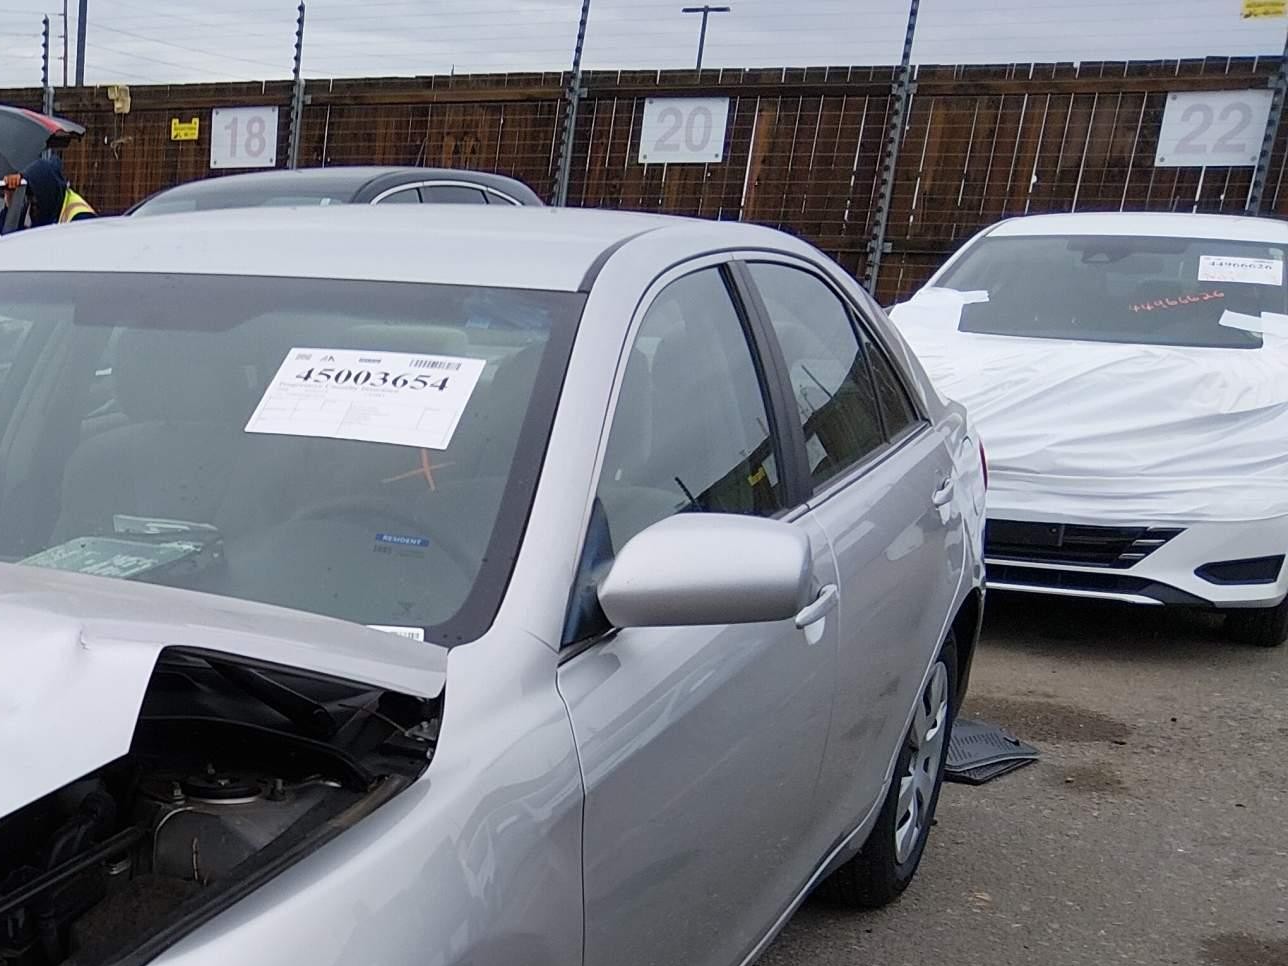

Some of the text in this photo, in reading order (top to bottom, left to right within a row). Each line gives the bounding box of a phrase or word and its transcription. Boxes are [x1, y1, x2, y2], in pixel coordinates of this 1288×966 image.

[223, 115, 267, 158] 18
[653, 106, 713, 153] 20
[1173, 101, 1255, 155] 22
[295, 366, 451, 393] 45003654
